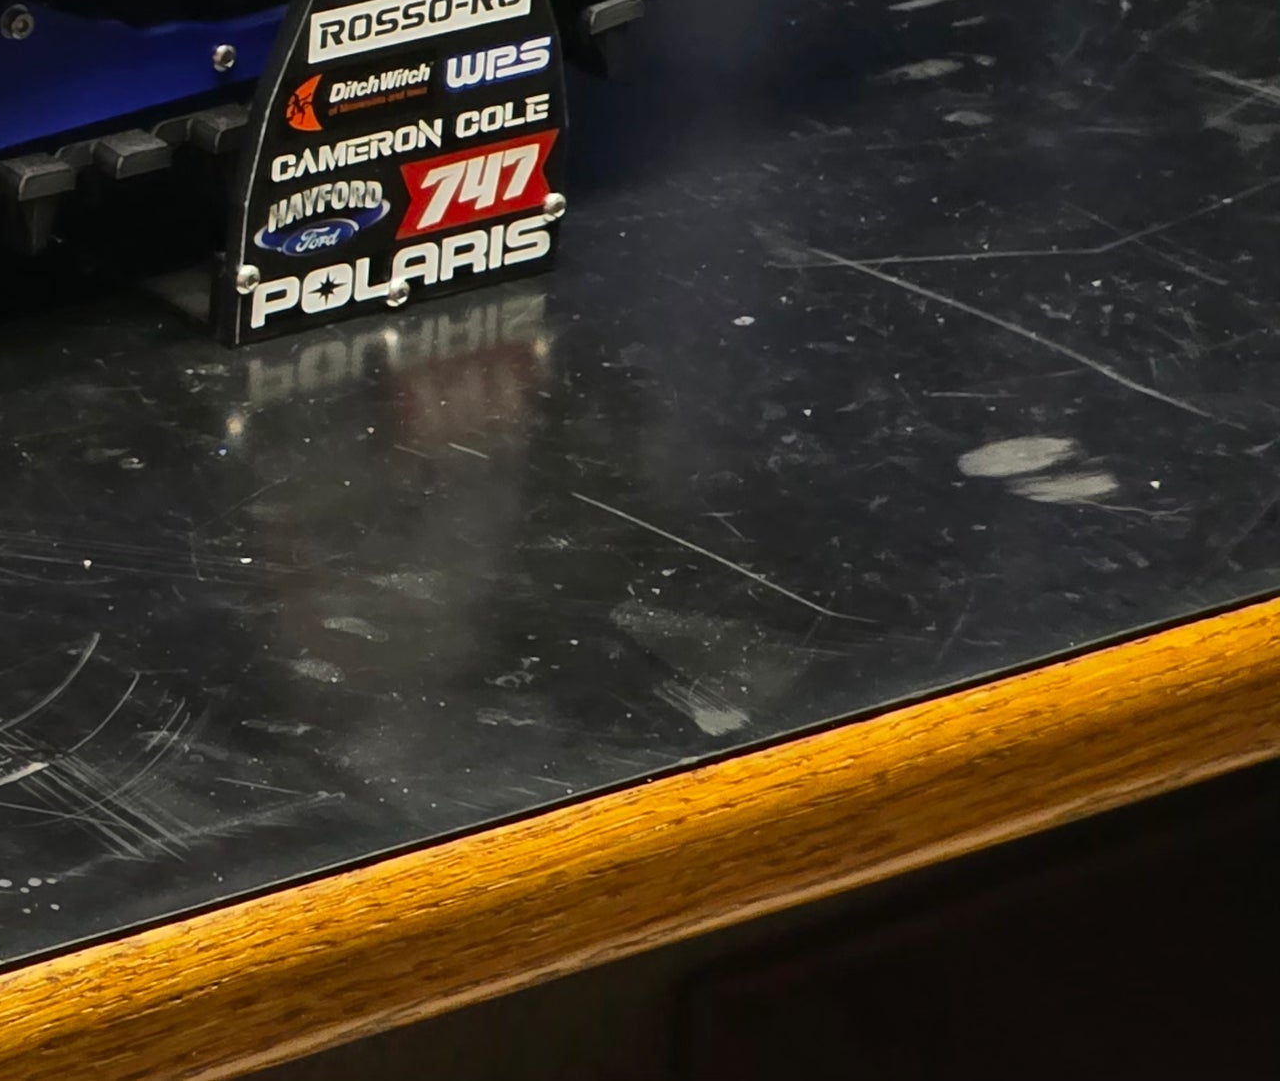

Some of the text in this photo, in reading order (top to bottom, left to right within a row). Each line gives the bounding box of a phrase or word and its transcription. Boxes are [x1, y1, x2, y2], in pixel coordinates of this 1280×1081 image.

[446, 36, 552, 89] WPS
[271, 118, 443, 184] CAMERON
[455, 93, 550, 139] COLE
[267, 180, 383, 234] HAYFORD
[416, 143, 541, 231] 747
[250, 216, 552, 330] POLARIS
[295, 226, 341, 254] Ford
